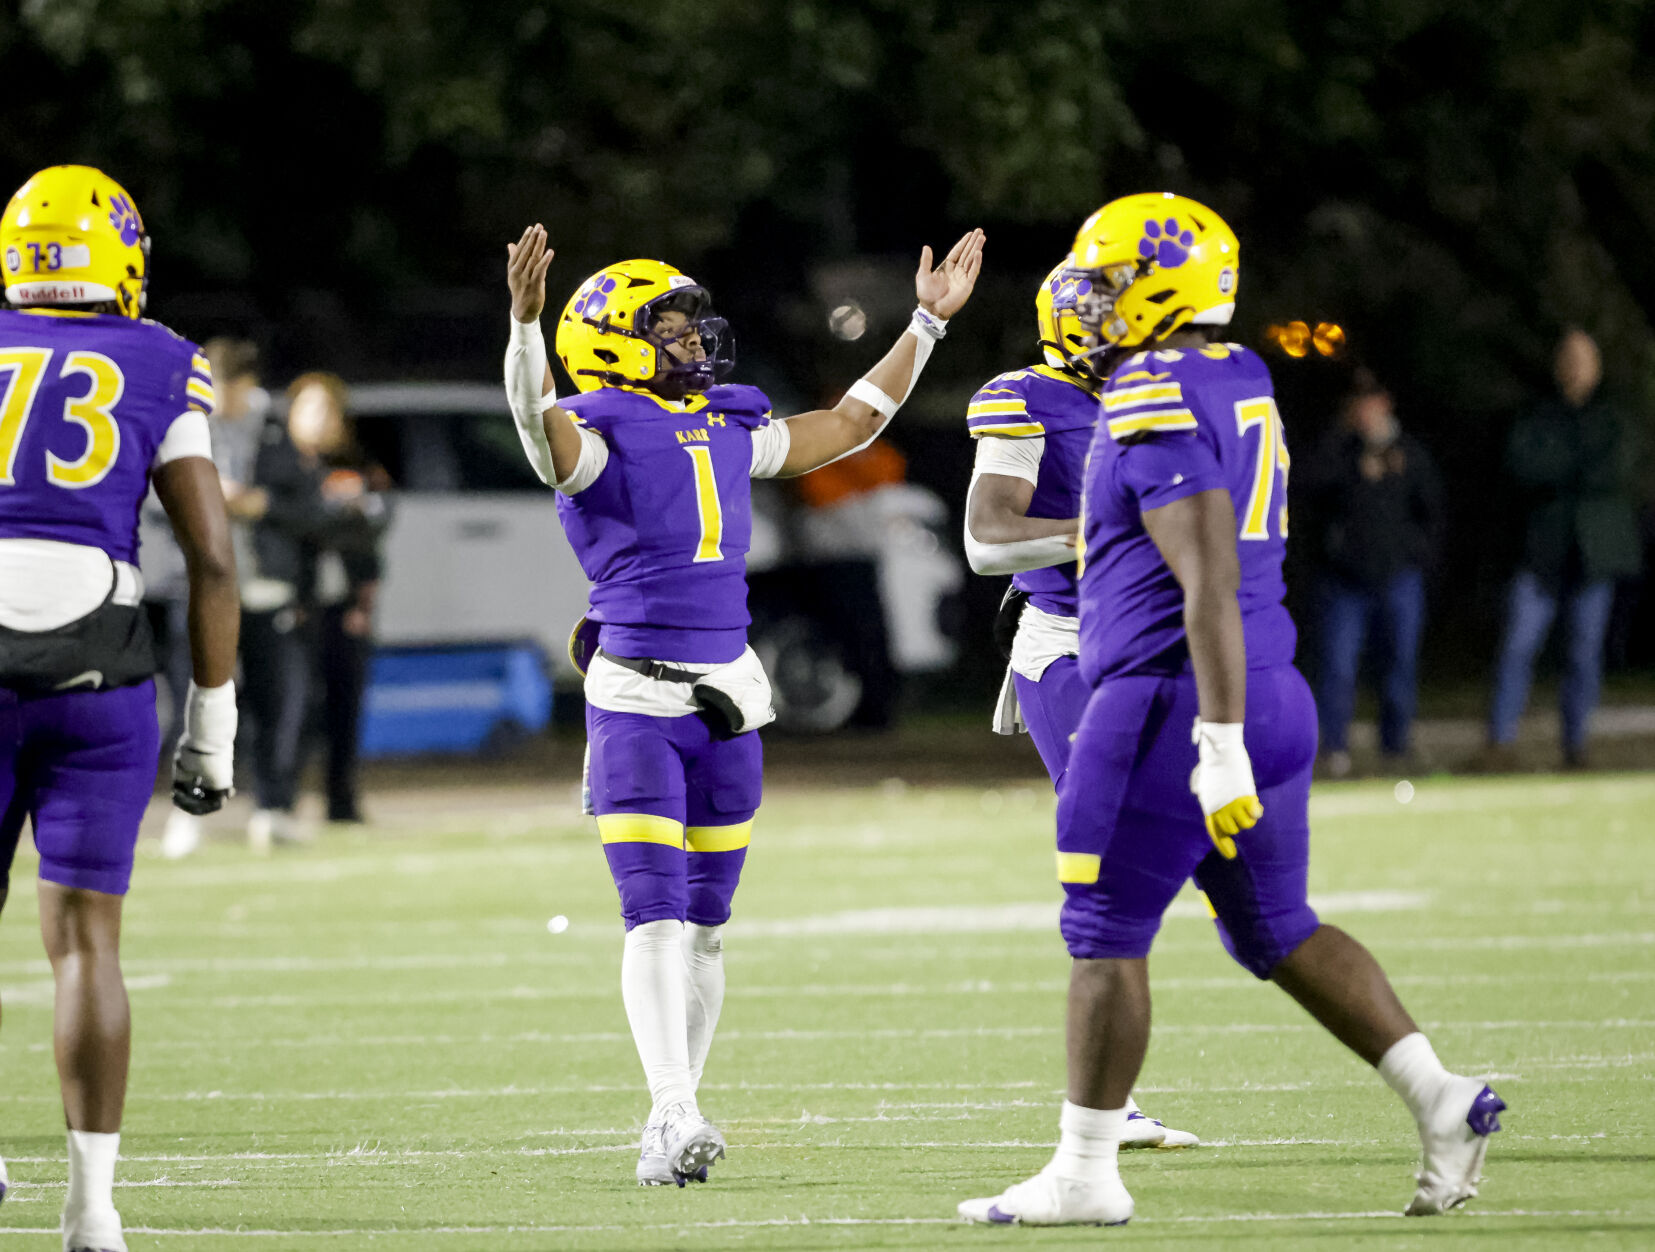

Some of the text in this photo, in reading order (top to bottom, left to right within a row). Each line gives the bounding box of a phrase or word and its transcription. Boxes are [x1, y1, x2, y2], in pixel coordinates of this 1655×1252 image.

[26, 241, 63, 272] 73
[0, 346, 125, 489] 73
[675, 428, 711, 444] KARR
[1234, 396, 1290, 541] 7
[683, 445, 725, 563] 1
